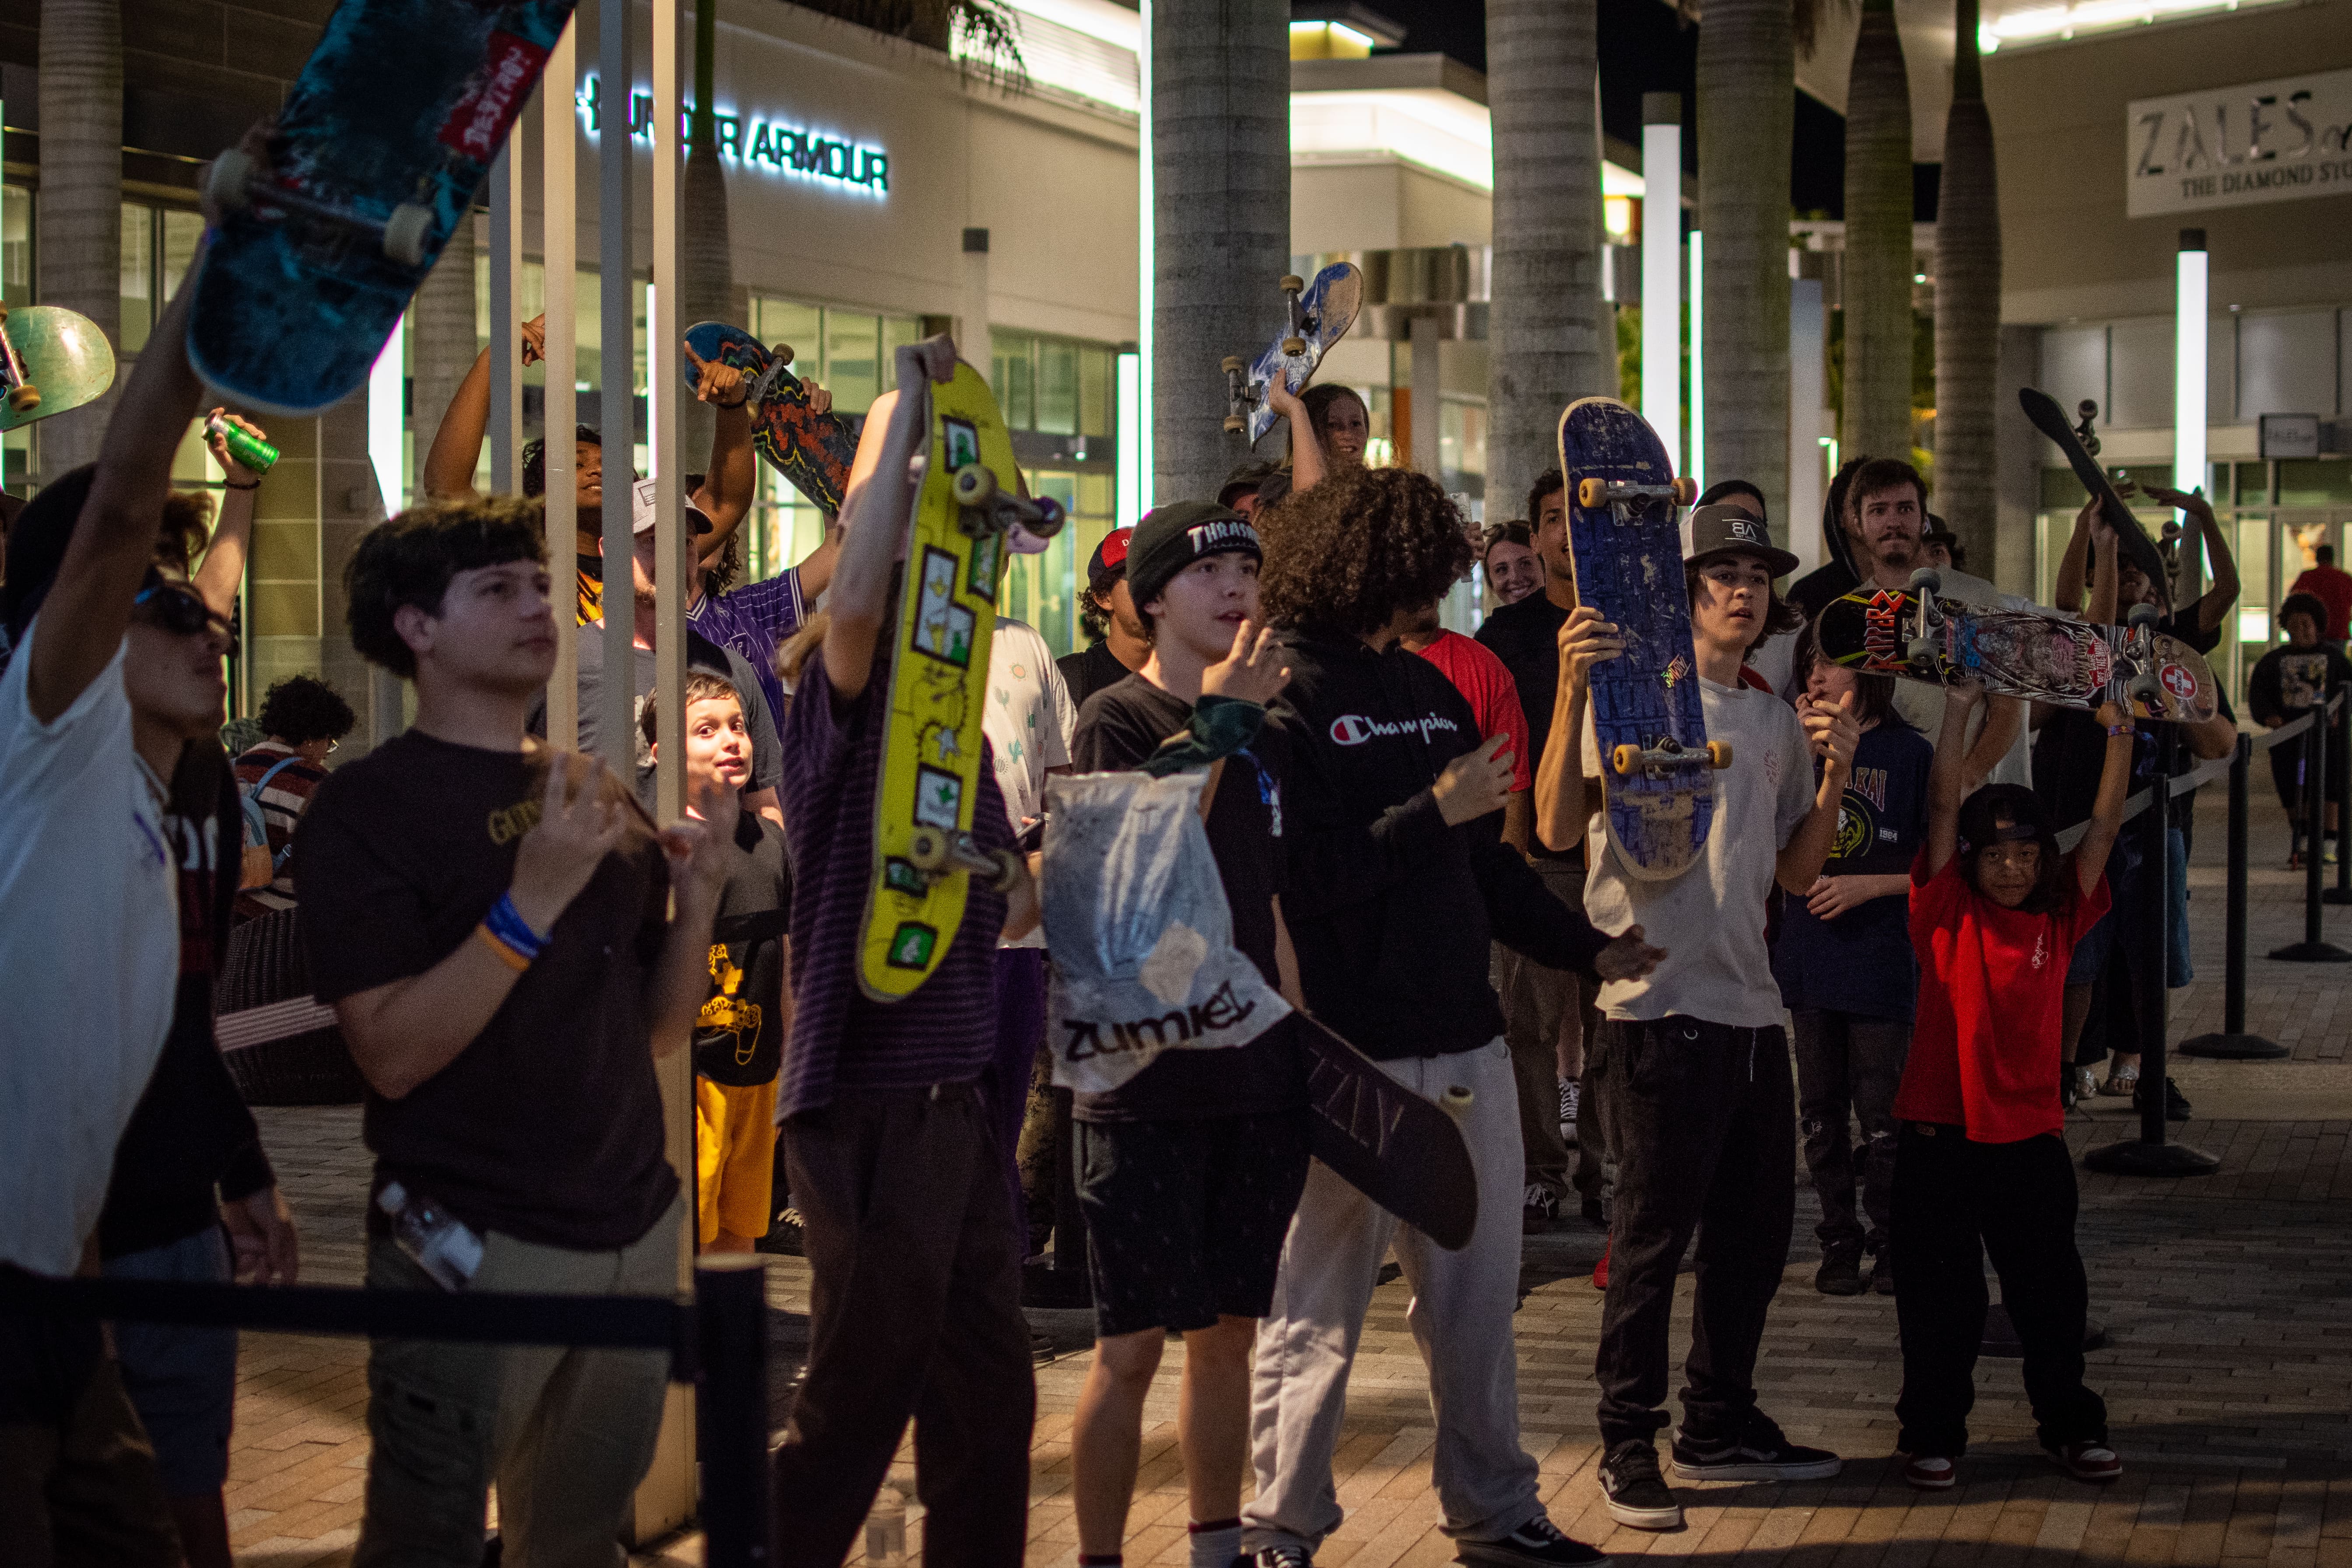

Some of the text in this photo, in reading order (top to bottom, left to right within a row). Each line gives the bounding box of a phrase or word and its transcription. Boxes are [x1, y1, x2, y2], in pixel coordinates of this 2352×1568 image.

[2136, 89, 2315, 178] ZALES
[744, 118, 888, 194] ARMOUR
[2182, 176, 2217, 199] THE
[2221, 164, 2313, 194] DIAMOND
[2094, 641, 2107, 656] WALL
[2096, 656, 2107, 669] THE
[1330, 711, 1458, 746] Champion
[1854, 767, 1887, 813] KAI
